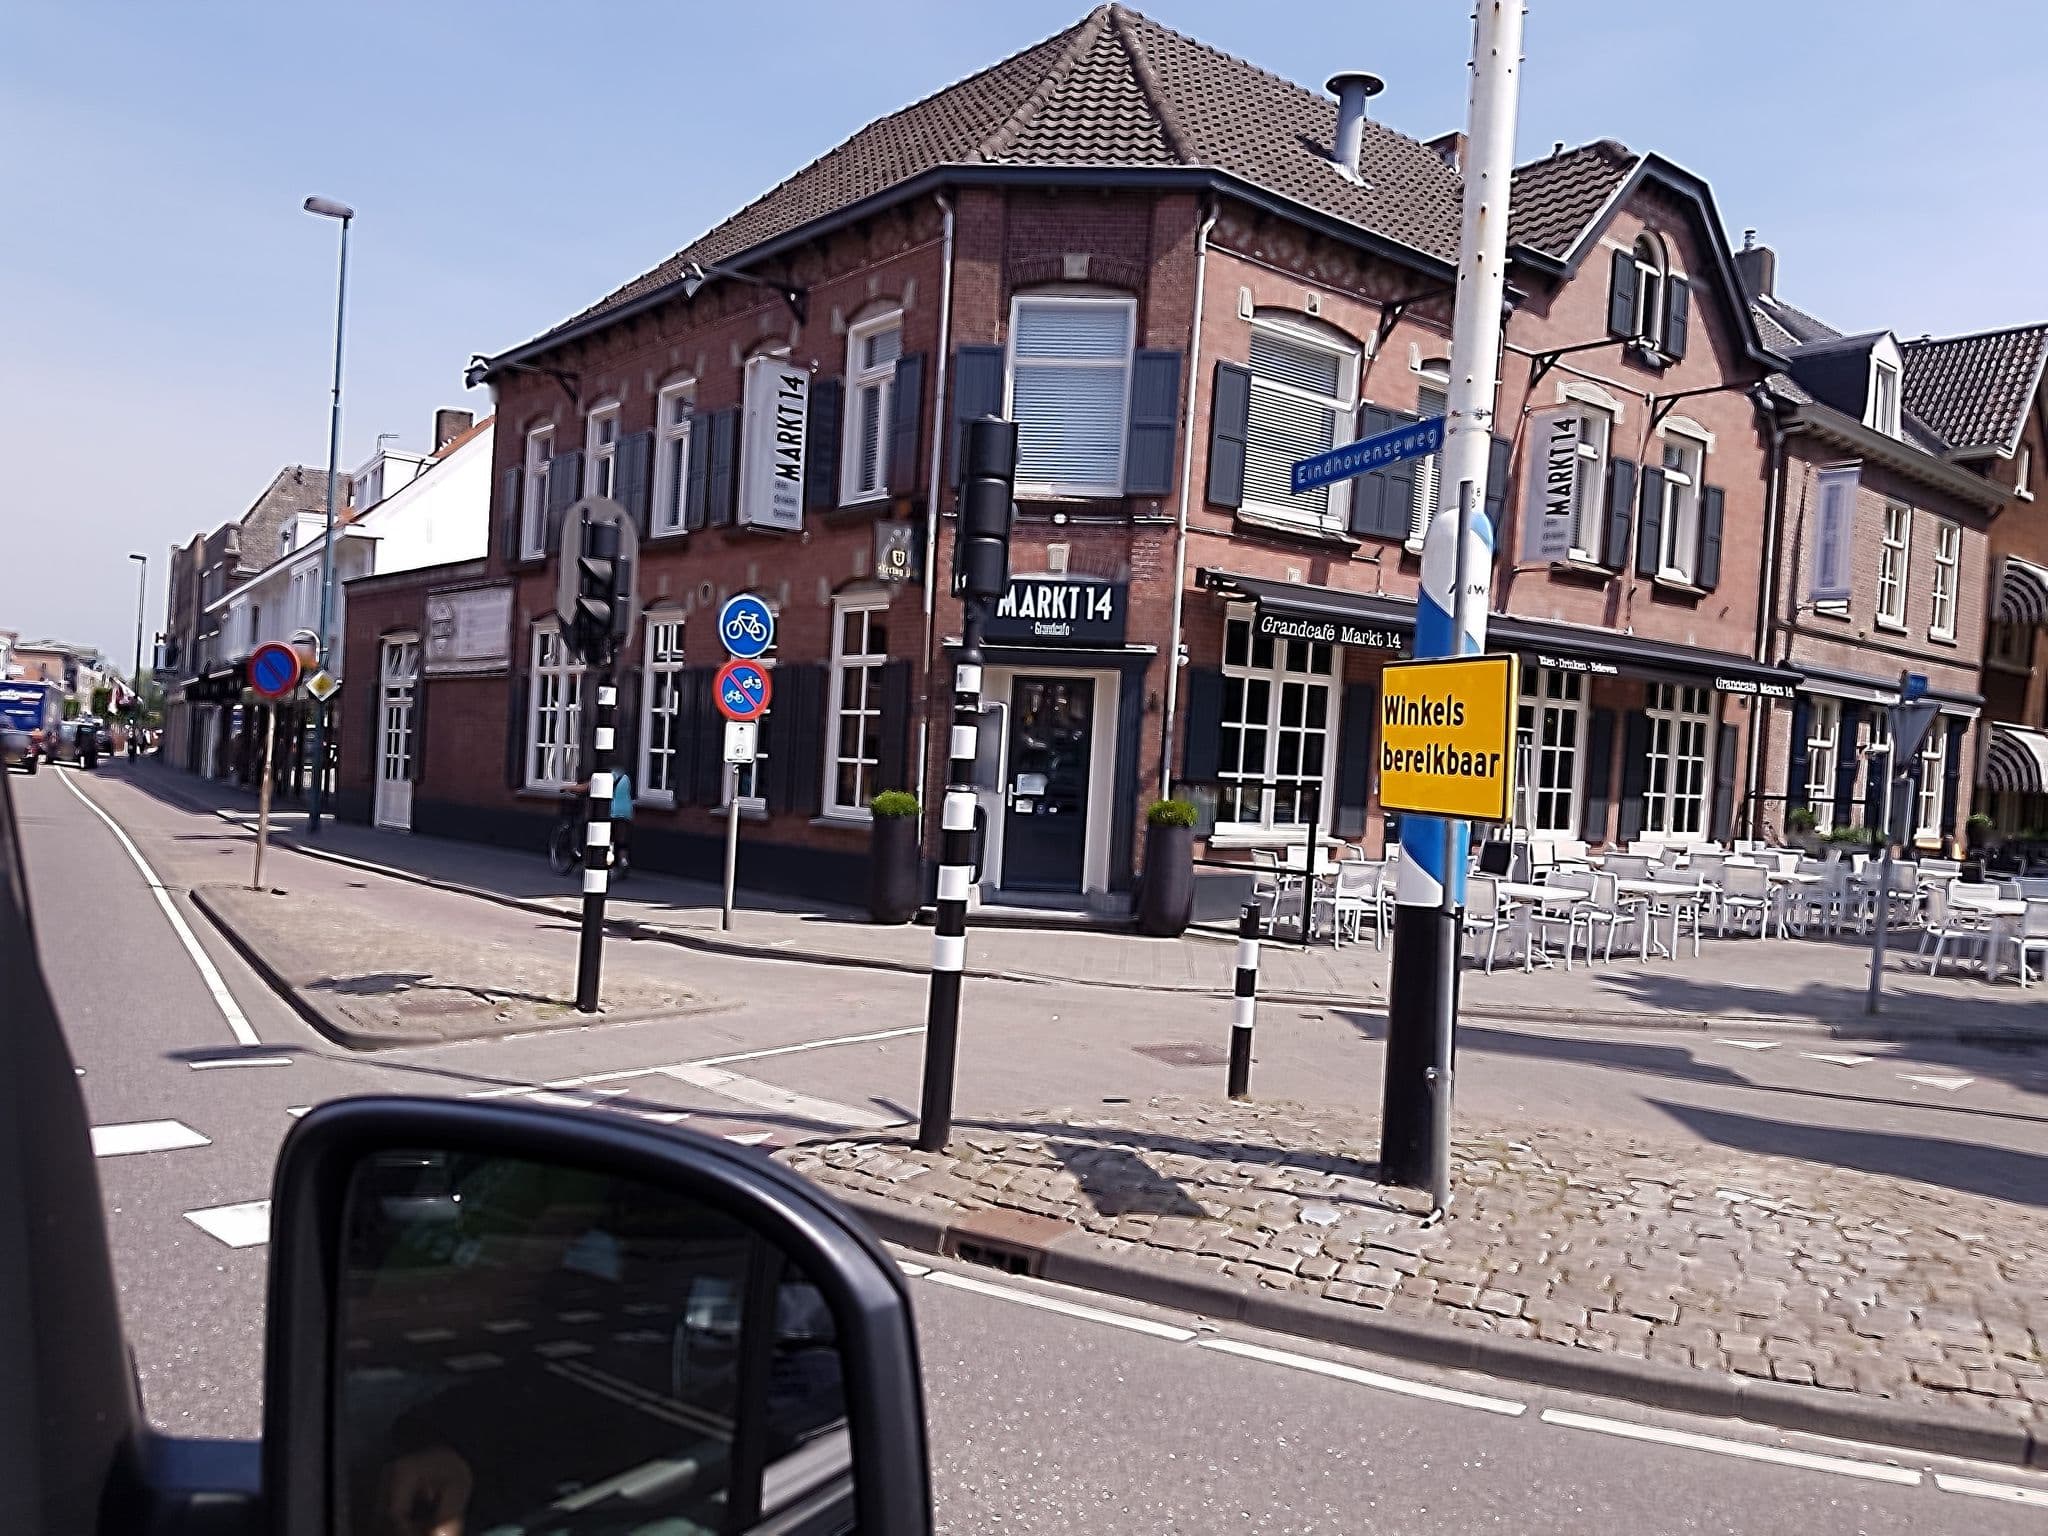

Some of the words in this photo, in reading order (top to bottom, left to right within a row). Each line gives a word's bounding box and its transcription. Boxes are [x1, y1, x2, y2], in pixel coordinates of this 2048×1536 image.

[779, 375, 805, 400] 14
[775, 404, 804, 482] MARKT
[1551, 419, 1577, 443] 14
[1297, 429, 1438, 484] Eindhovenseweg
[1545, 449, 1575, 516] MARKT
[997, 584, 1080, 619] MARKT
[1086, 587, 1113, 620] 14
[1261, 616, 1335, 641] Grandcafé
[1341, 626, 1384, 647] Markt
[1386, 632, 1402, 649] 14
[1384, 694, 1465, 726] Winkels
[1383, 741, 1501, 778] bereikbaar
